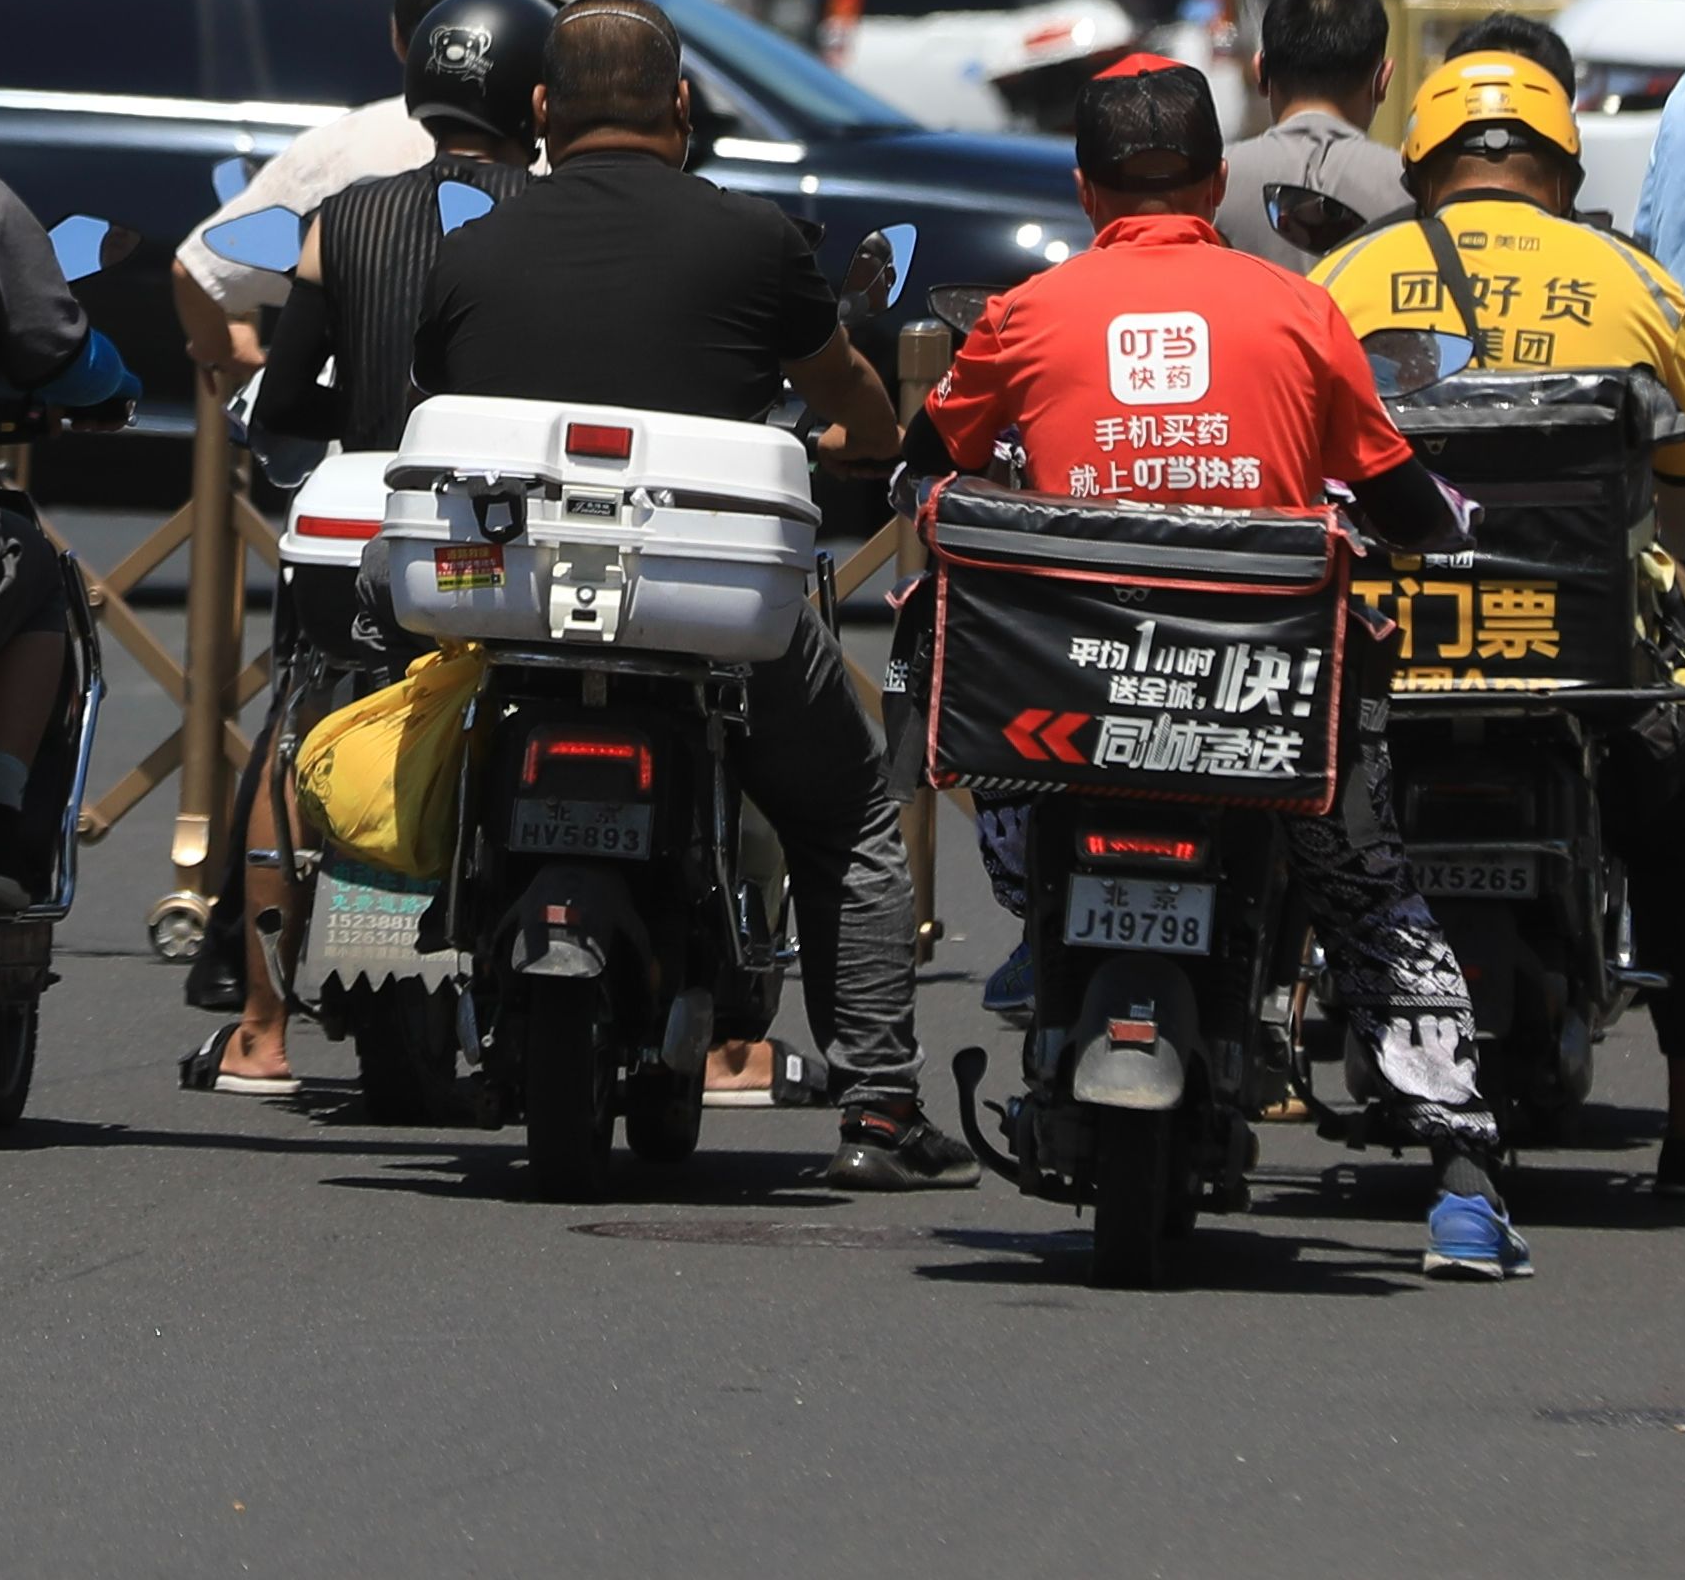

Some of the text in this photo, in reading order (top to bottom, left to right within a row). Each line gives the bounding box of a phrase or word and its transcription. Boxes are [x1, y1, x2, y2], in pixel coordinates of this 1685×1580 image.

[1494, 235, 1540, 252] 美团
[1391, 271, 1597, 327] 团好货
[1120, 326, 1197, 359] 叮当
[1129, 365, 1191, 390] 快药
[1094, 413, 1230, 452] 手机买药
[1069, 456, 1261, 498] 就上叮当快药
[1067, 620, 1216, 677] 平均1小时
[1093, 712, 1304, 779] 同城急送
[521, 823, 640, 851] HV5893
[1103, 885, 1178, 910] 北京
[327, 913, 419, 930] 1523881
[1075, 909, 1200, 946] J19798
